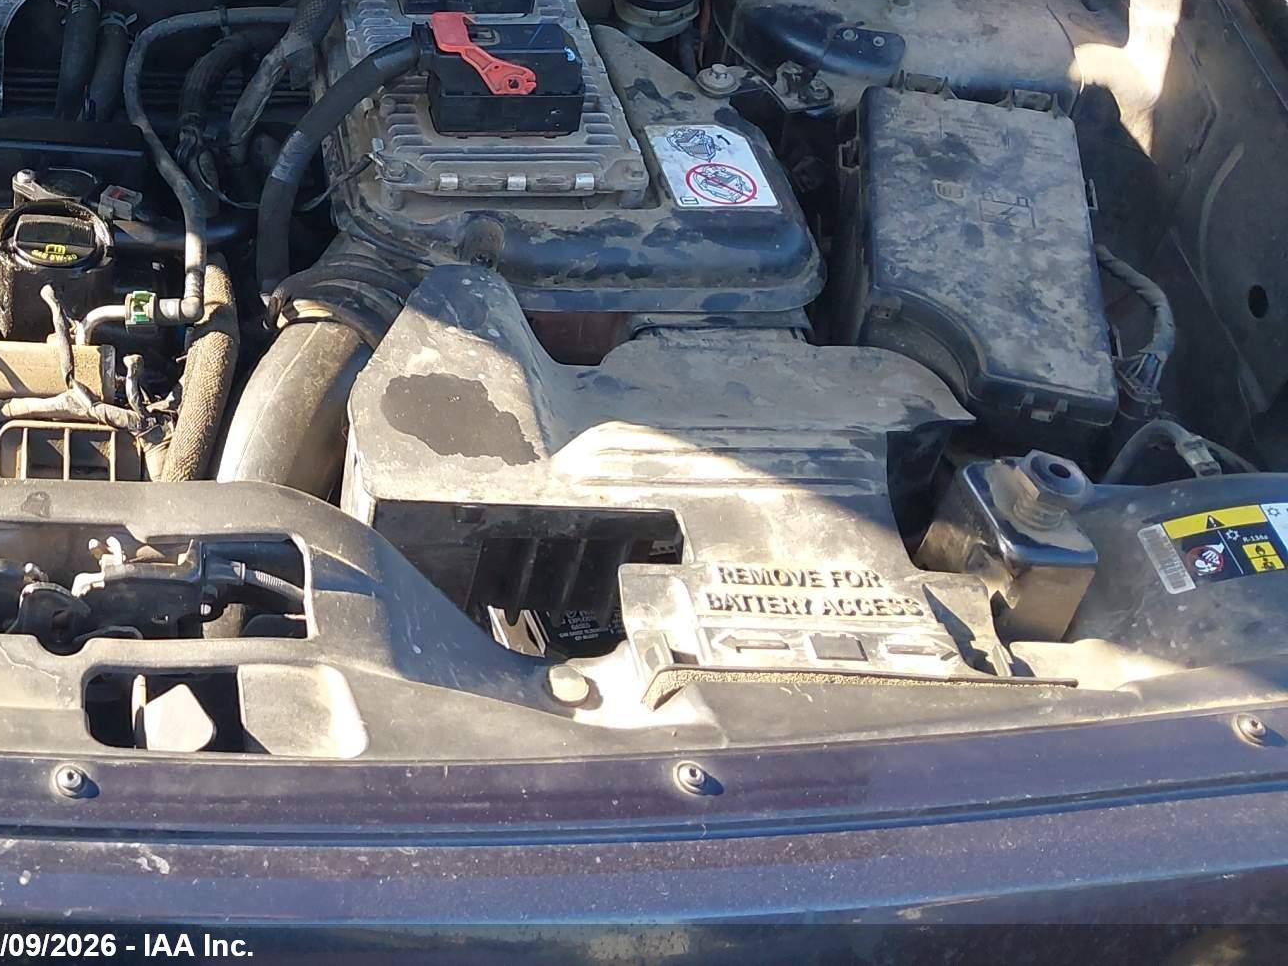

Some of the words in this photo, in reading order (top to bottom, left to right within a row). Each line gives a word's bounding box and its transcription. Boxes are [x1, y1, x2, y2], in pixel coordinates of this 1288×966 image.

[717, 566, 823, 588] REMOVE
[832, 569, 884, 588] FOR
[706, 592, 813, 615] BATTERY
[823, 596, 924, 616] ACCESS
